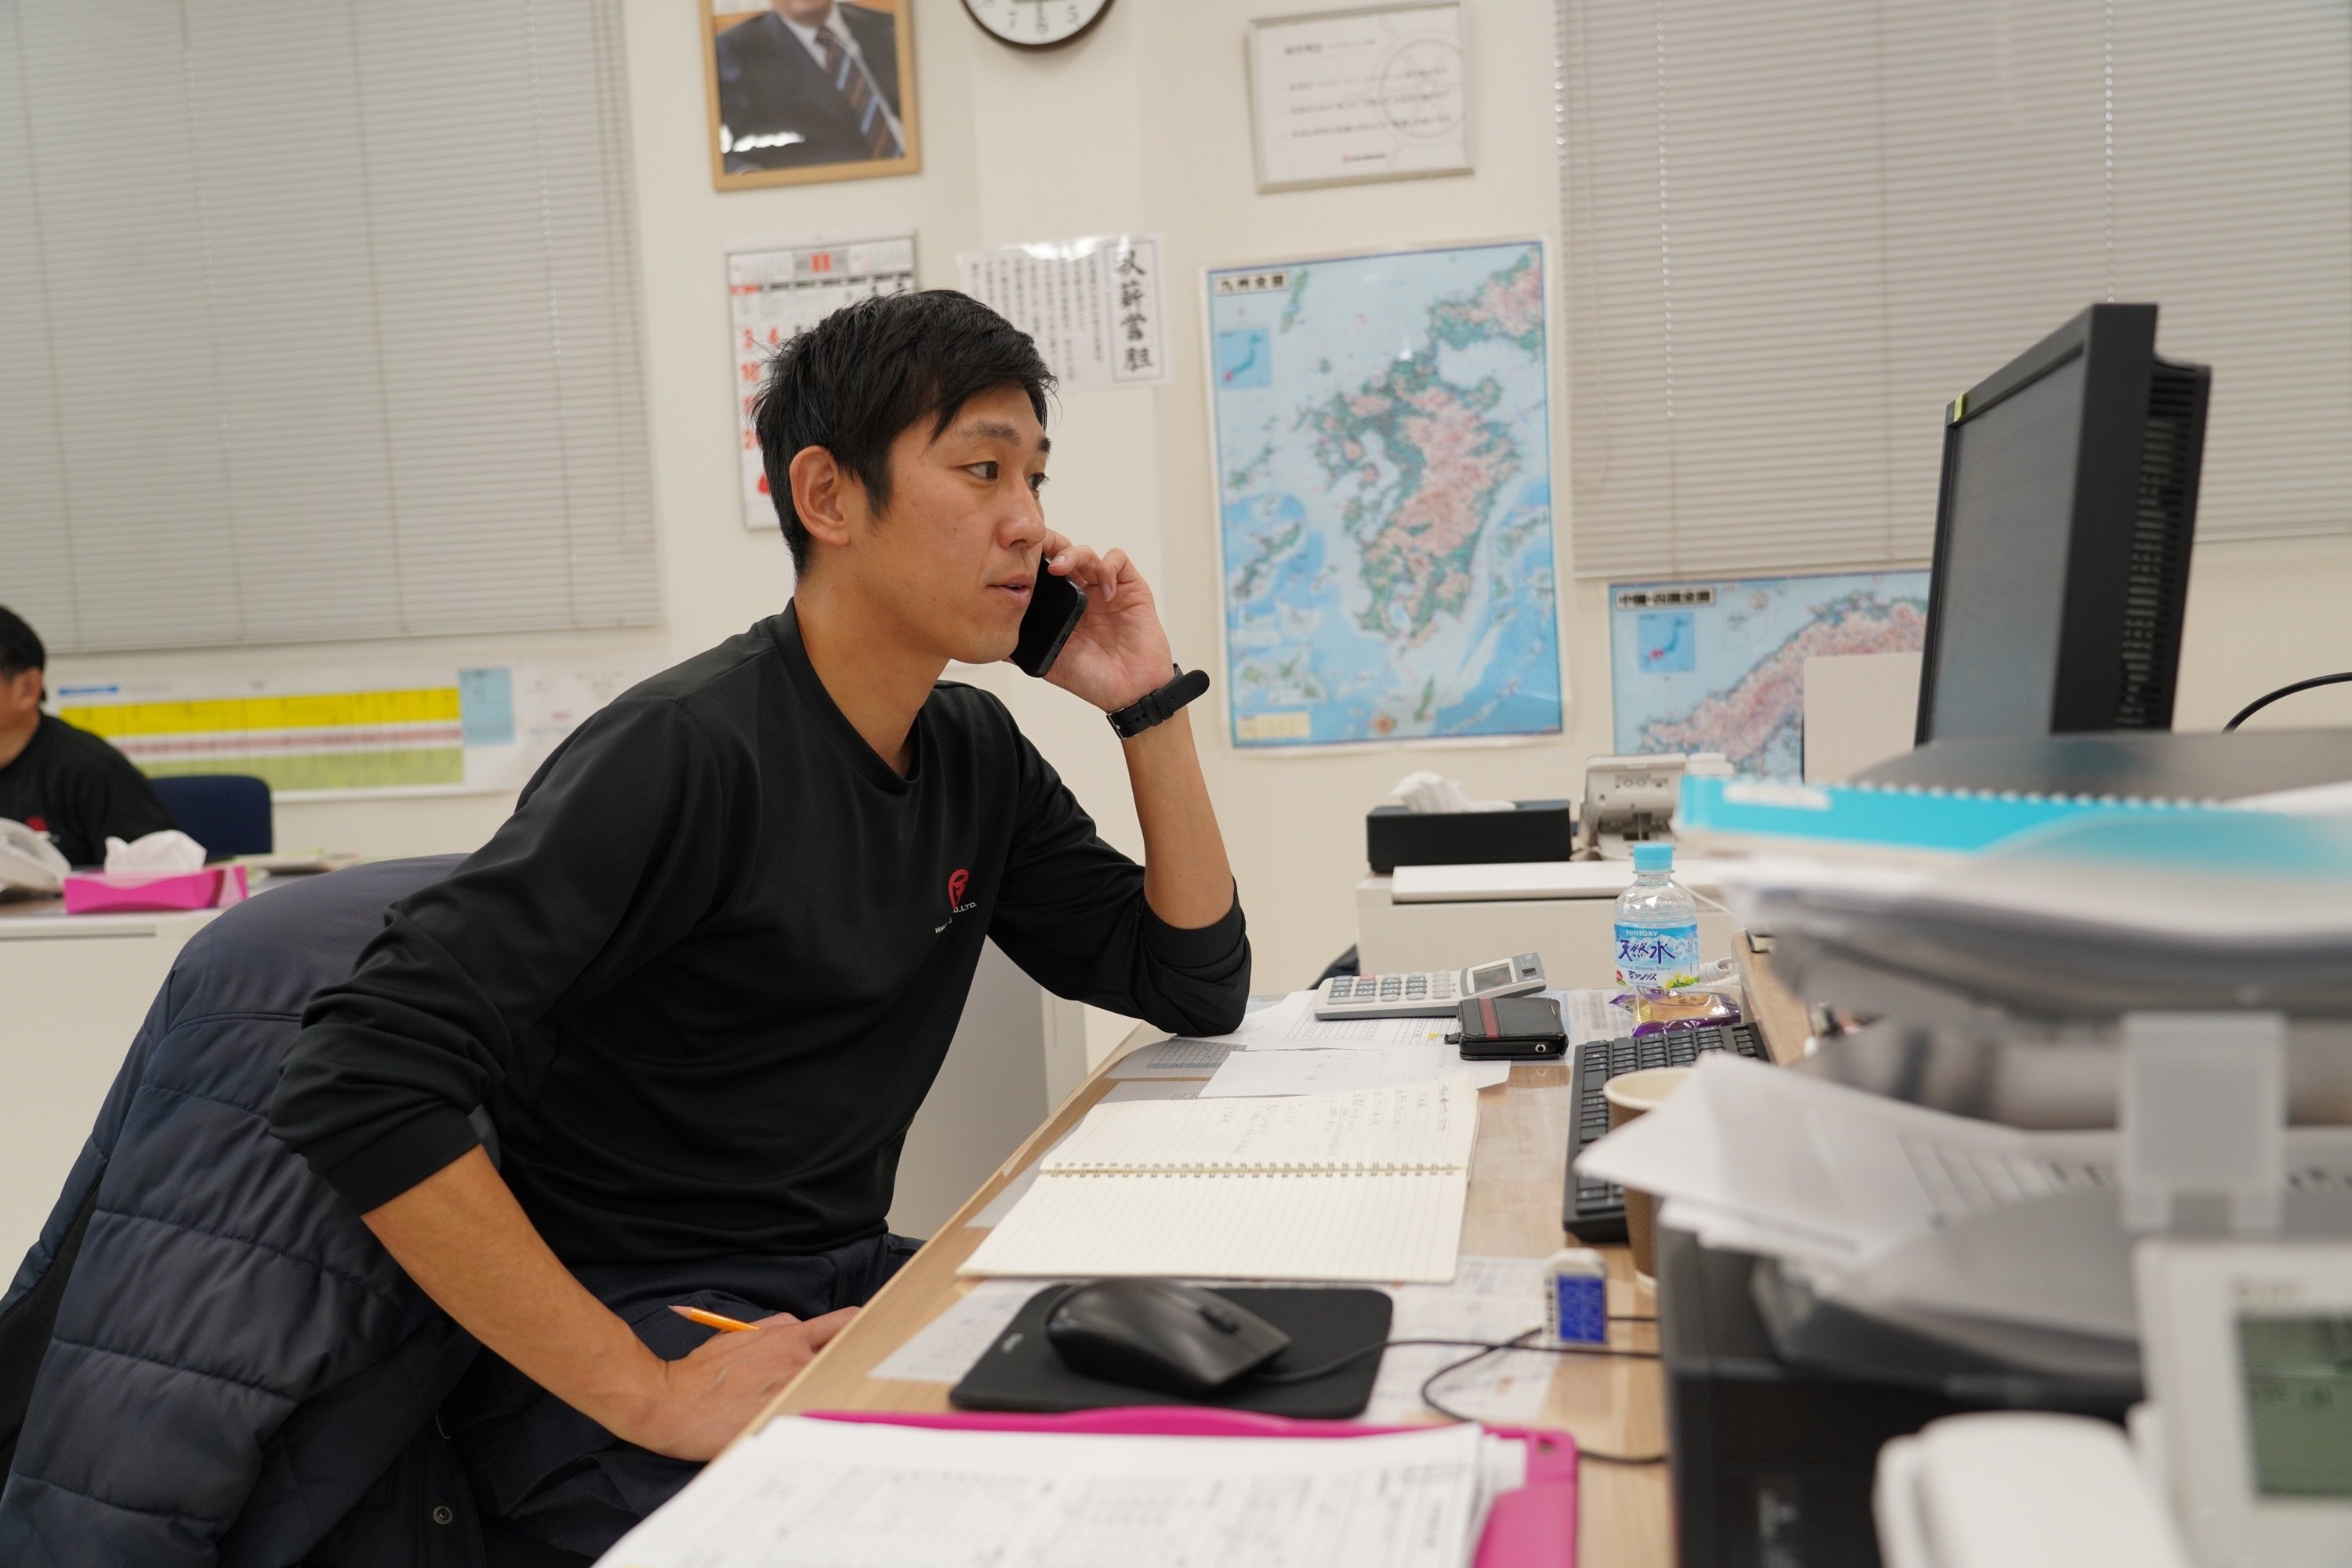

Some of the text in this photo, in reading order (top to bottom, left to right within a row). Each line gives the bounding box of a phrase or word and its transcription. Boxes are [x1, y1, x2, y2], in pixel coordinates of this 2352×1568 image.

[811, 252, 831, 273] 11
[1618, 939, 1675, 964] 天然水
